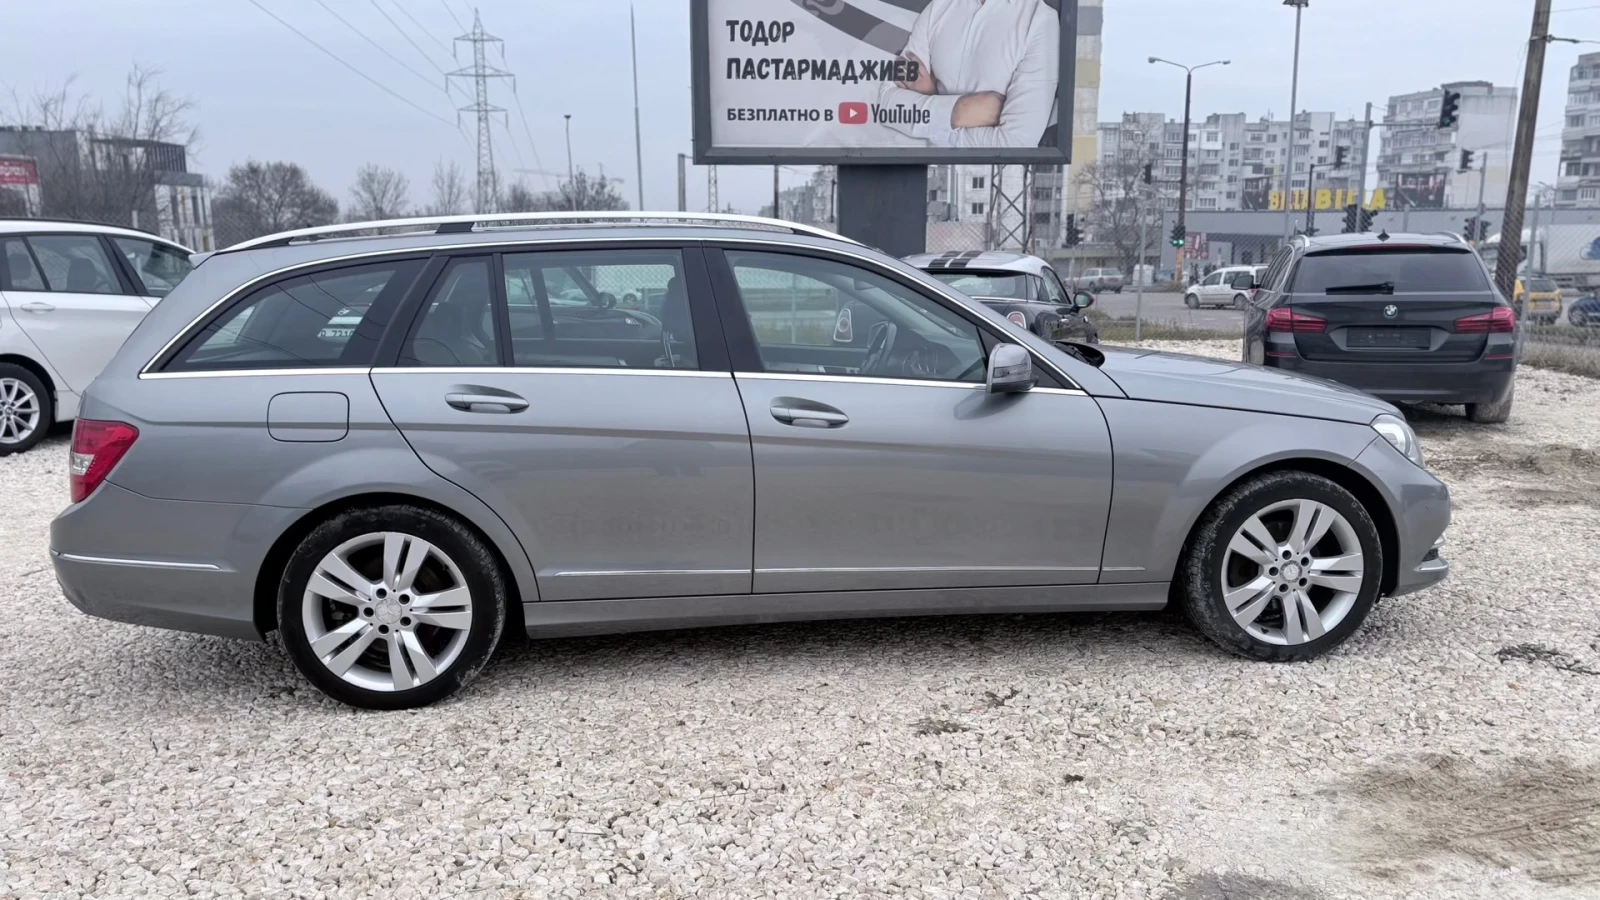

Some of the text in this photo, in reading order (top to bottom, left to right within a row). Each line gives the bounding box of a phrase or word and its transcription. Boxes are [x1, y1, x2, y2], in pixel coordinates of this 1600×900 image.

[726, 19, 795, 46] ТОДОР
[726, 57, 919, 85] ПАСТАРМАДЖИЕВ
[727, 103, 931, 125] БЕЗПЛАТНО В YouTube
[1269, 189, 1310, 210] BILA
